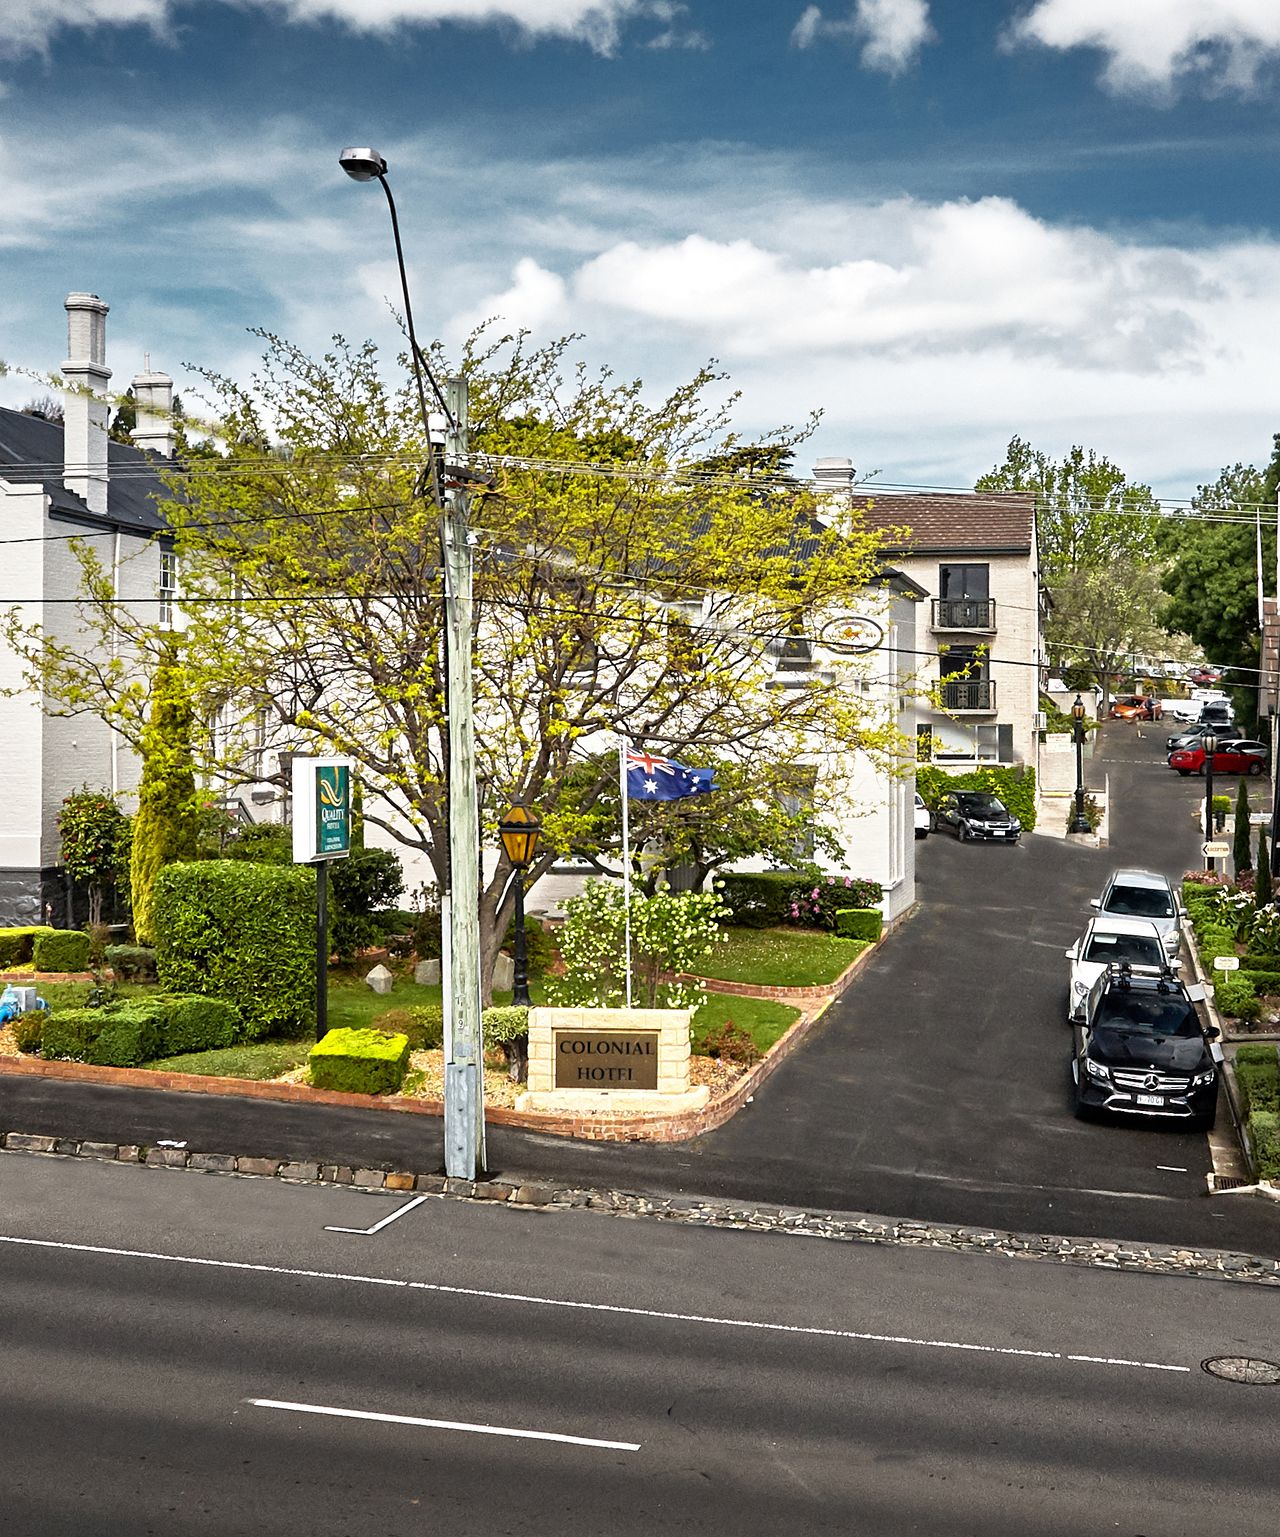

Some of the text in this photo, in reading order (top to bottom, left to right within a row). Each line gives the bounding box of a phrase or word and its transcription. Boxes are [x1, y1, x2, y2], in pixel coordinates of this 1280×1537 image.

[321, 807, 345, 823] QUALITY
[560, 1040, 656, 1056] COLONIAL
[577, 1066, 637, 1082] HOTEL
